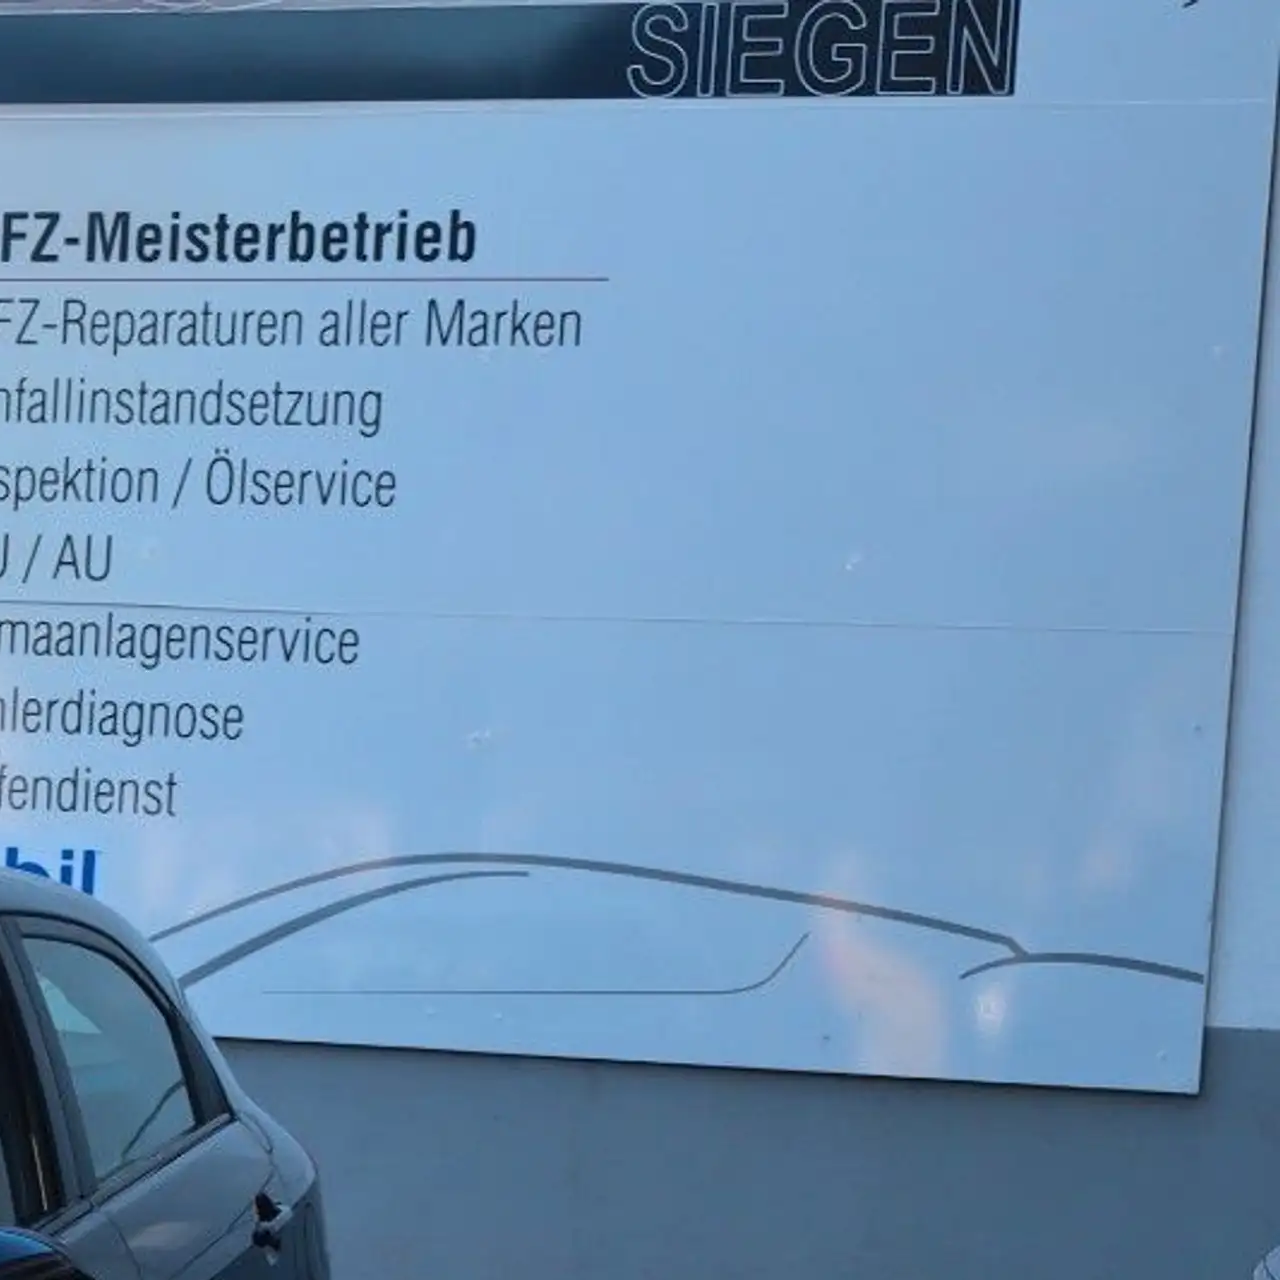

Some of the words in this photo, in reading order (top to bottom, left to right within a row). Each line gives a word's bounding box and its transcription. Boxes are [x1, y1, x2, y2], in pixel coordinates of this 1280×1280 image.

[626, 0, 1017, 98] SIEGEN
[319, 298, 410, 347] aller
[426, 298, 581, 347] Marken
[172, 458, 192, 510] /
[206, 448, 396, 507] Ölservice
[22, 533, 43, 584] /
[52, 533, 112, 581] AU
